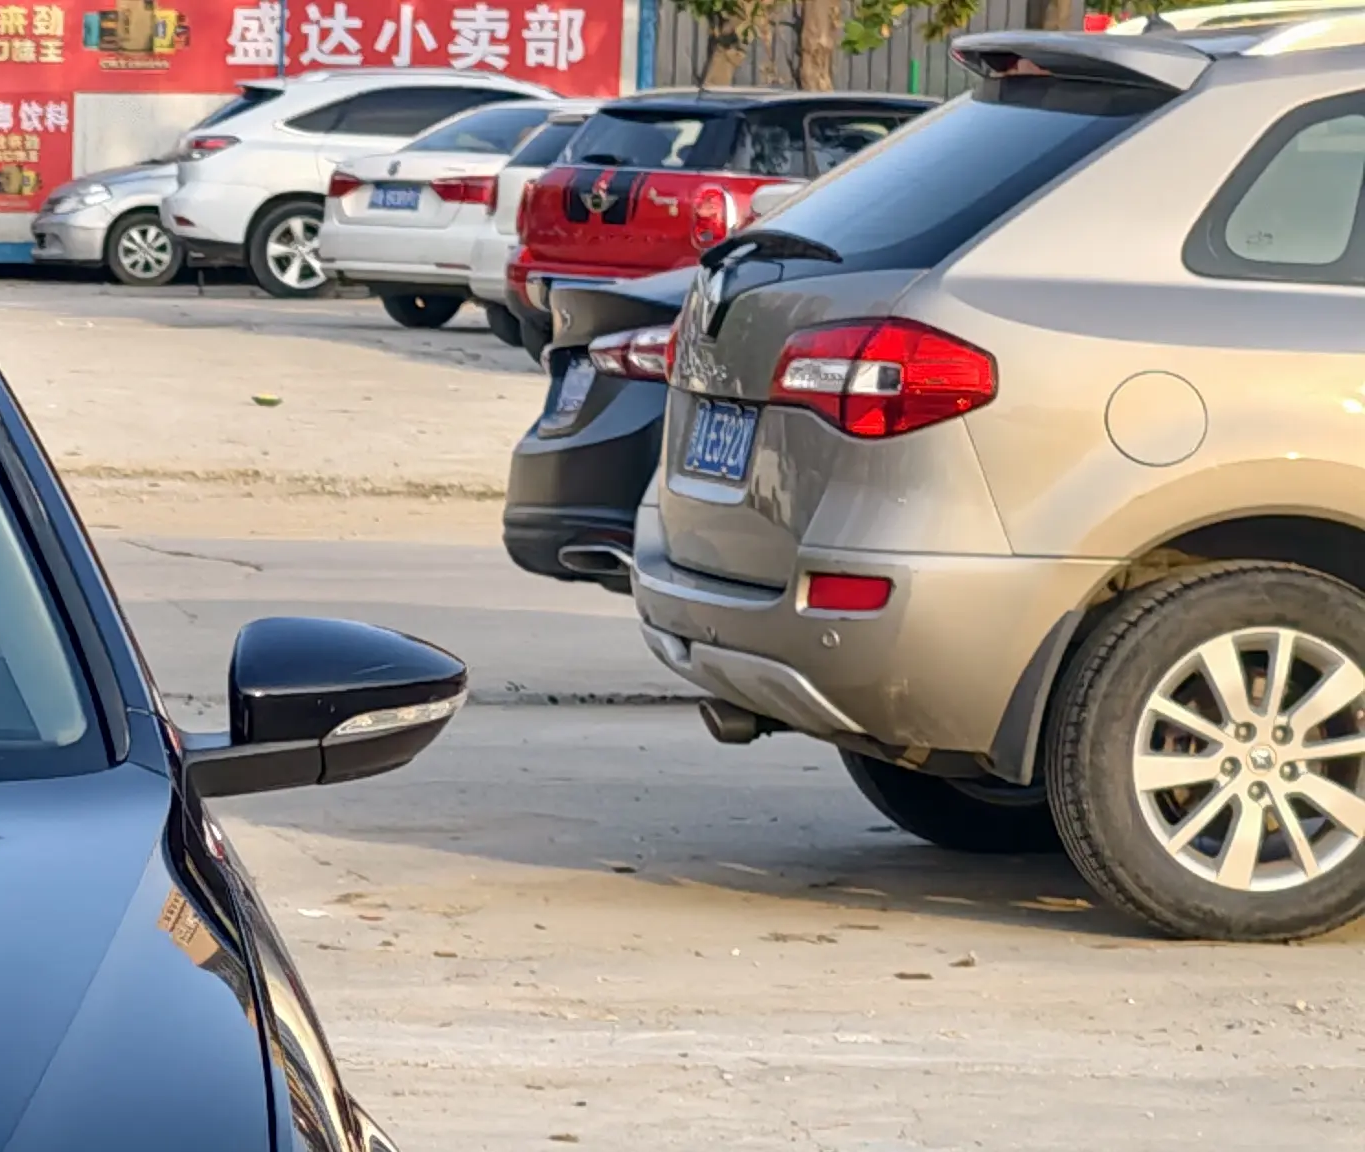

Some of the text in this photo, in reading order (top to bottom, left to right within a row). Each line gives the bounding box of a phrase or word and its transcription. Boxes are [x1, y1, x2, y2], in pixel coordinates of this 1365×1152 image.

[226, 2, 585, 70] 盛达小卖部
[19, 99, 69, 132] 饮料
